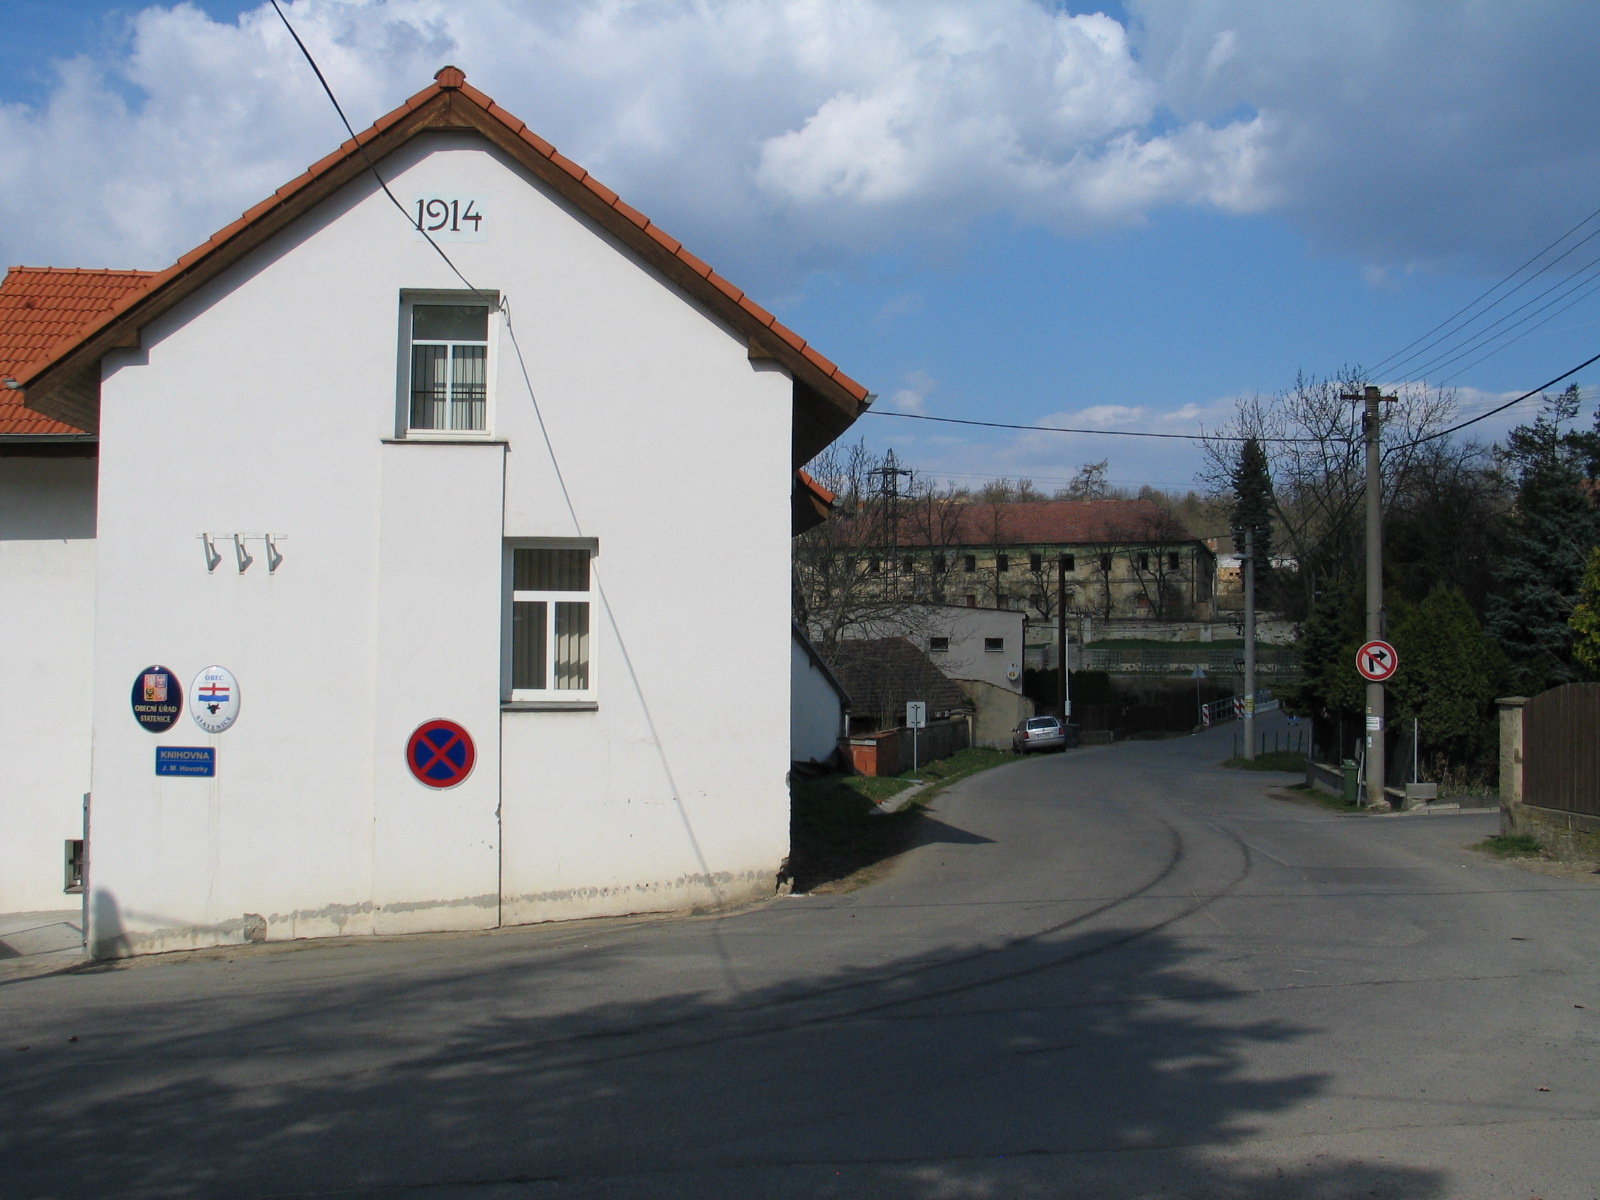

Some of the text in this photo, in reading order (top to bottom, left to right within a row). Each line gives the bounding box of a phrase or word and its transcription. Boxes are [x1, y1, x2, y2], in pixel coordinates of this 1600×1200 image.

[415, 199, 483, 232] 1914
[196, 715, 232, 731] STATENICE
[160, 750, 210, 760] KNIHOVNA
